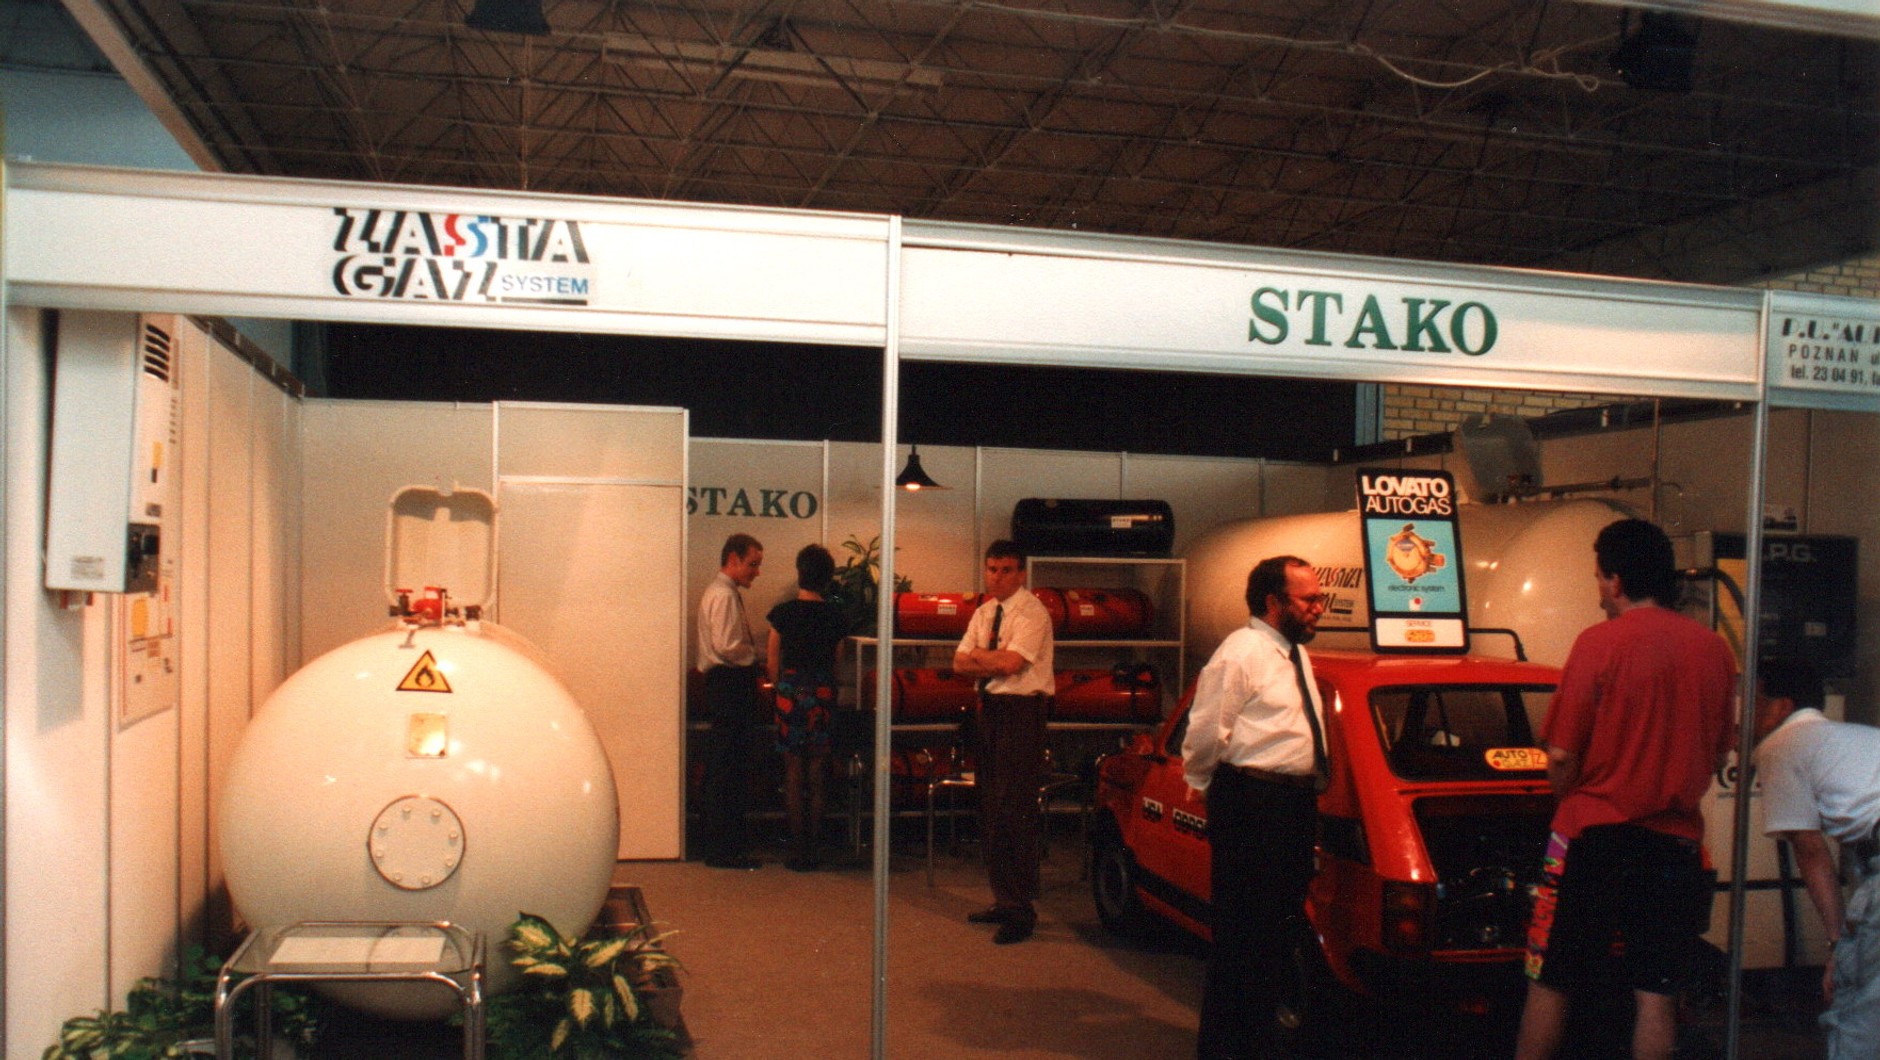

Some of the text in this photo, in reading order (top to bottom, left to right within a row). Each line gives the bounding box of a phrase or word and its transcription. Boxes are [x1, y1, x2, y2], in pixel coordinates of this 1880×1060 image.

[332, 255, 588, 302] GAZ SYSTEM
[1248, 286, 1498, 356] STAKO
[1813, 366, 1828, 381] 23
[1361, 475, 1450, 498] LOVATO
[686, 486, 818, 519] STAKO
[1366, 496, 1452, 515] AUTOGAS
[1491, 750, 1528, 759] AUTO
